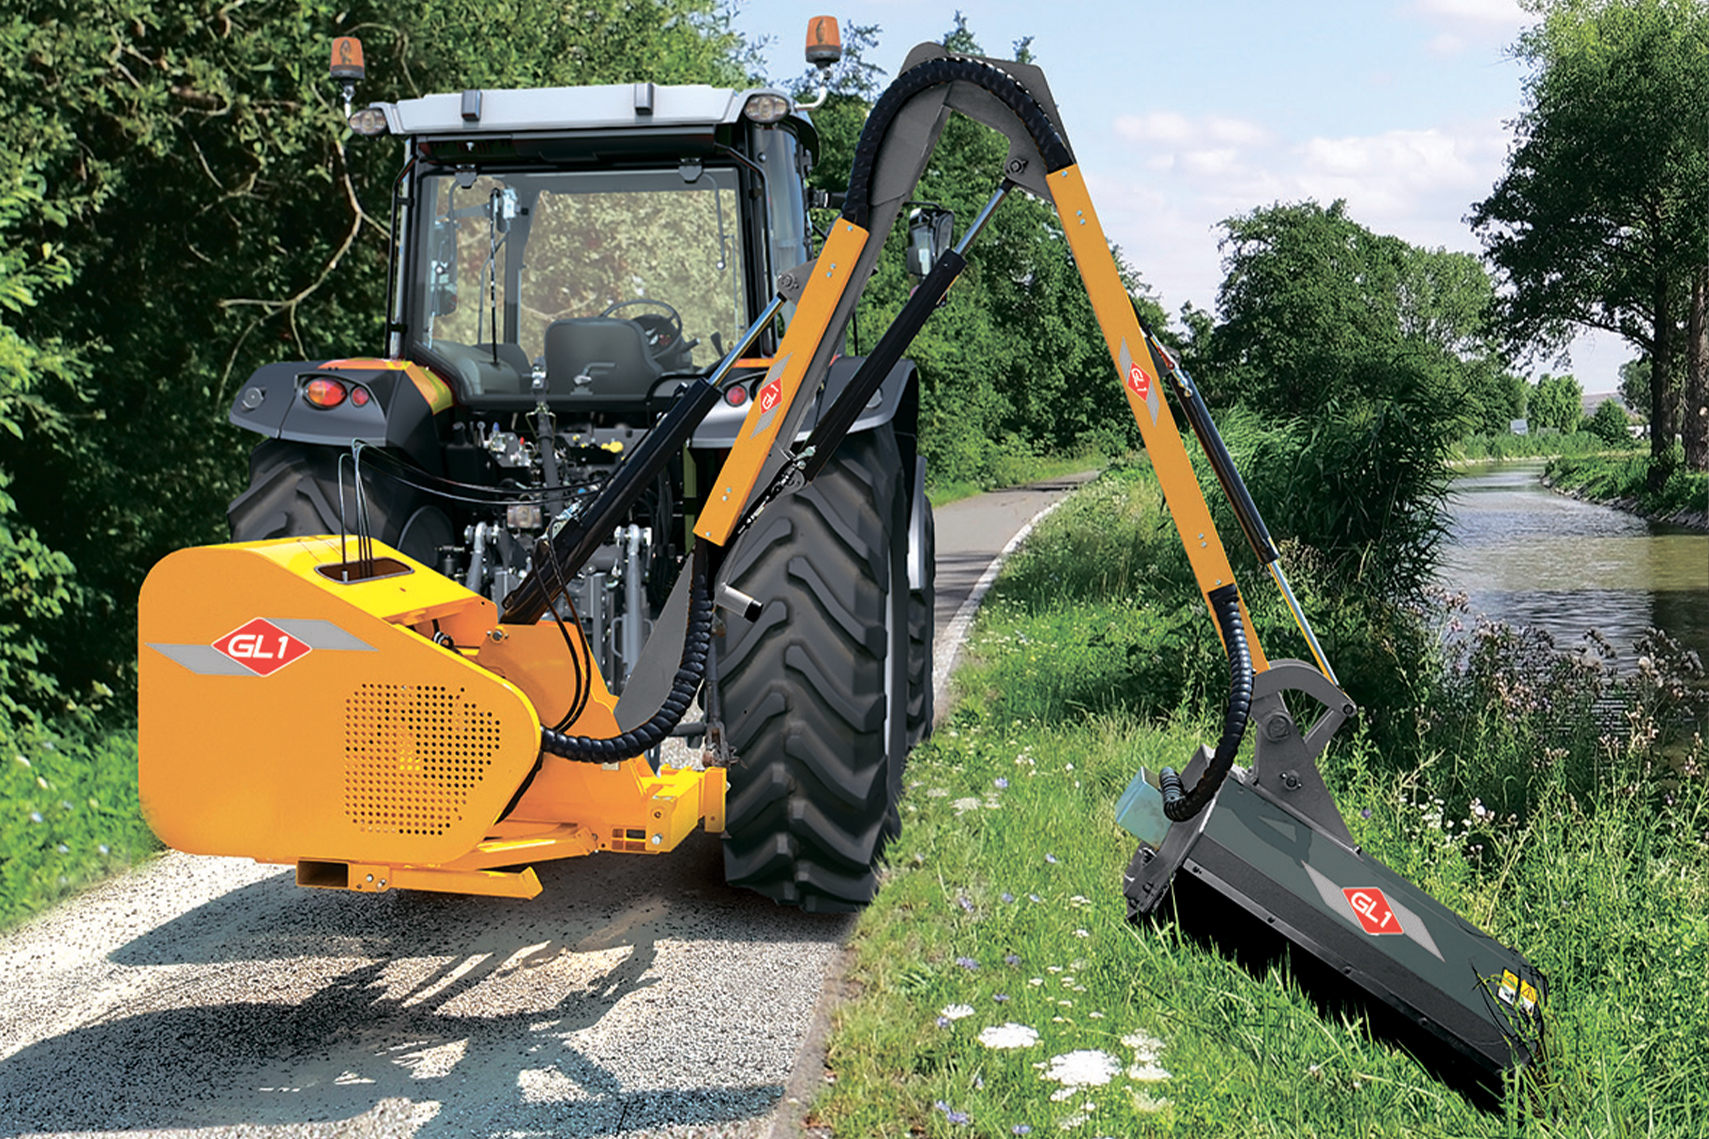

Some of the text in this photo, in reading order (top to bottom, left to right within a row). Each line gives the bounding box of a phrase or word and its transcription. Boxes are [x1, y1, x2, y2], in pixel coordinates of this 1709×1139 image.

[762, 384, 779, 409] GL1
[228, 634, 289, 659] GL1
[1351, 892, 1392, 928] GL1
